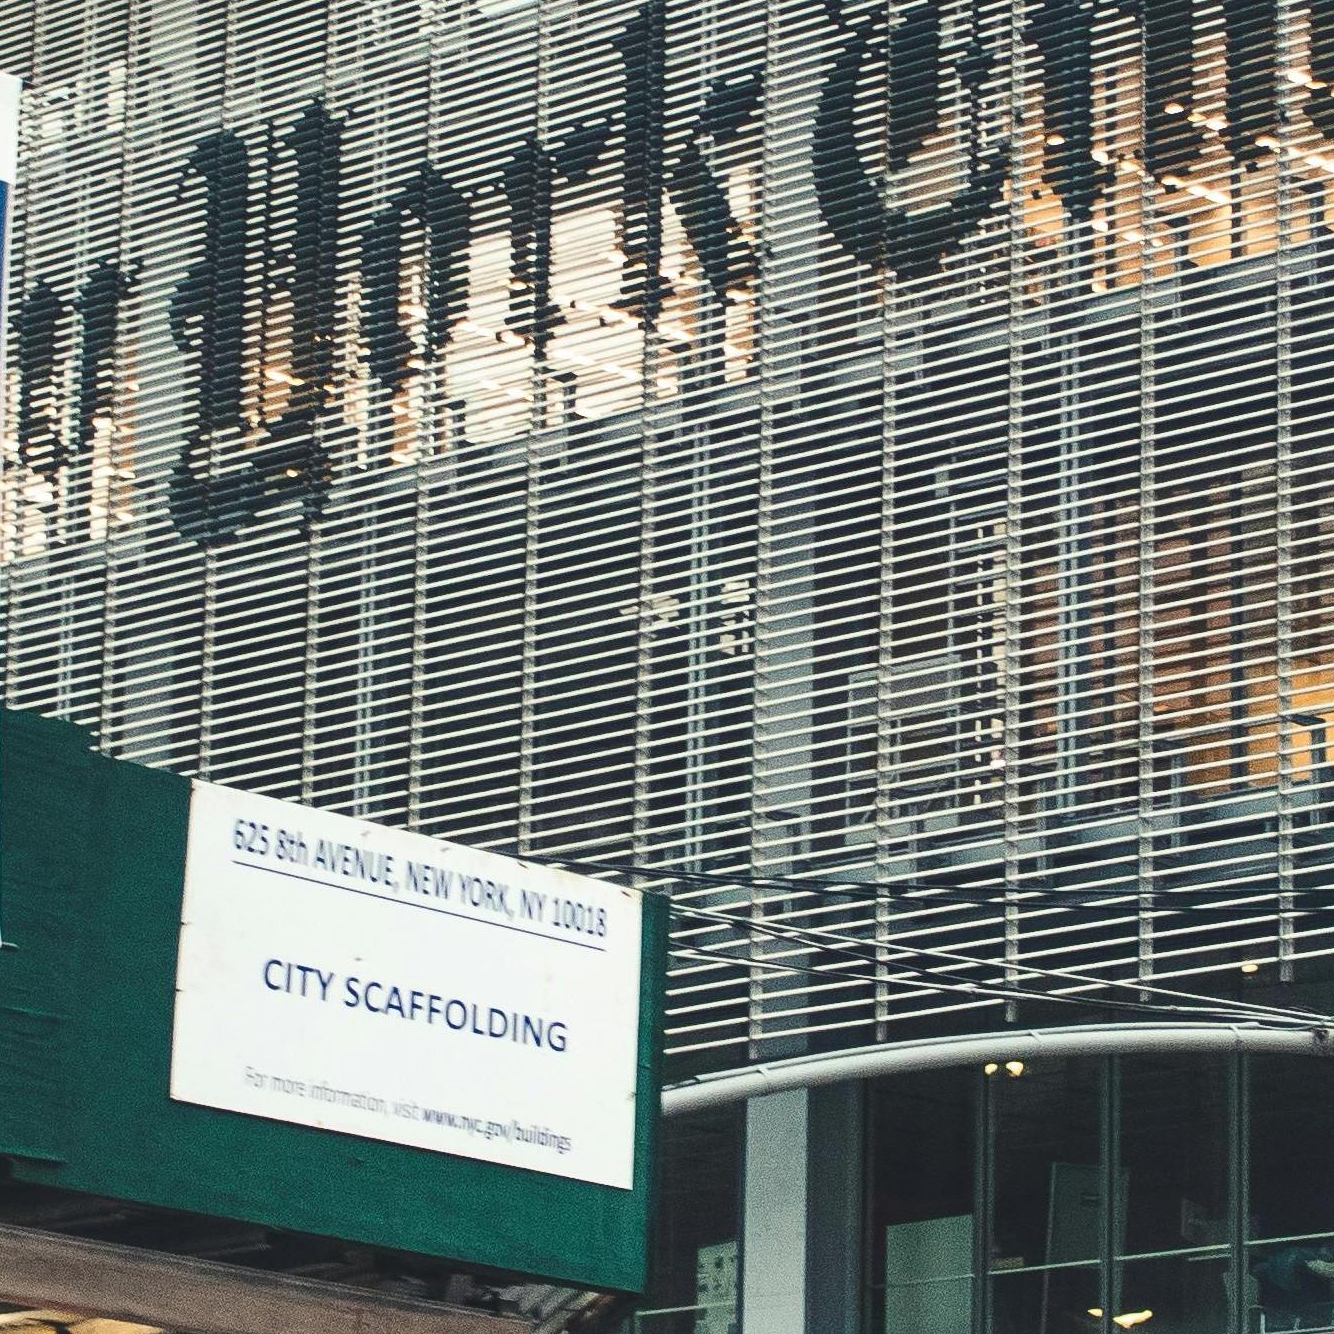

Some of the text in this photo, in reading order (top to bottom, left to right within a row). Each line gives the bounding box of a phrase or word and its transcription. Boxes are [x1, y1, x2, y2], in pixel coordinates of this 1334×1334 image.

[233, 818, 608, 937] 625 8th AVENUE, NEW YORK, NY 10018
[263, 958, 569, 1053] CITY SCAFFOLDING
[245, 1066, 269, 1090] For
[271, 1075, 307, 1098] more
